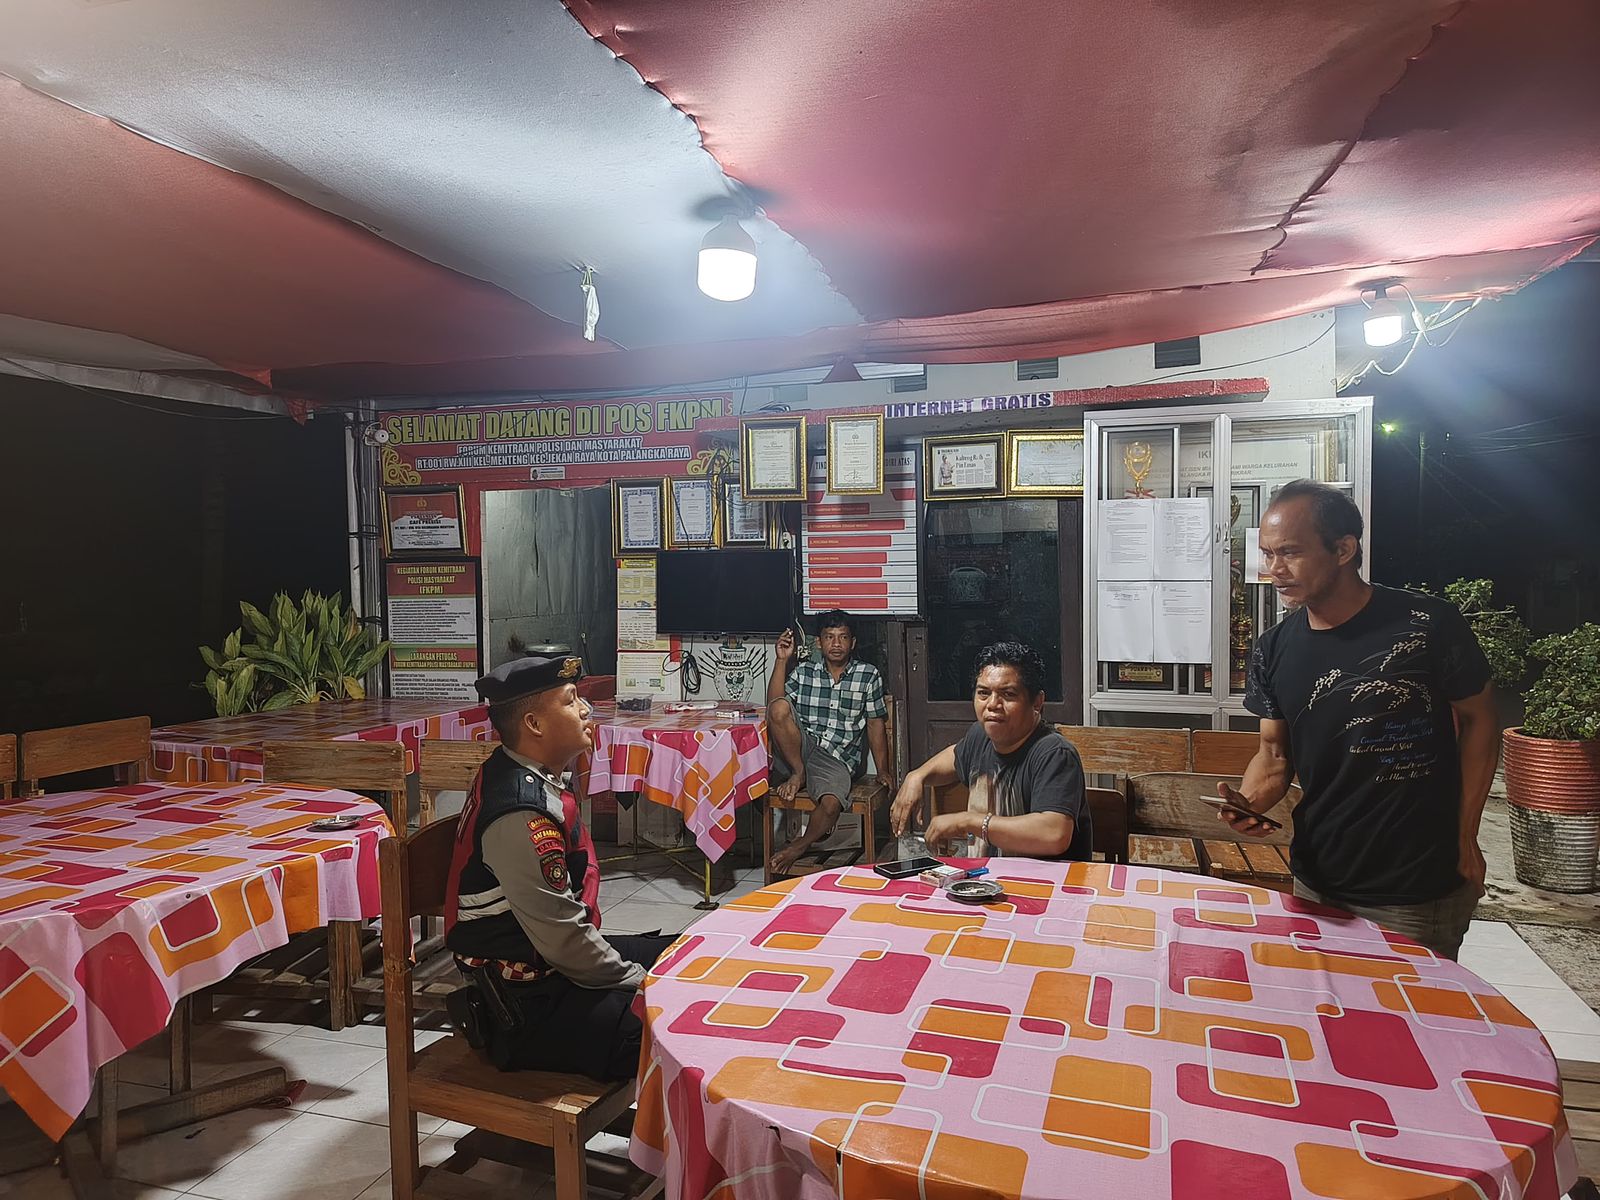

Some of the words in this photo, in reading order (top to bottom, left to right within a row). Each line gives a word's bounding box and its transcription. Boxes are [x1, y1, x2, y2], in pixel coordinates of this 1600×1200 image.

[887, 400, 974, 417] INTERNET
[981, 392, 1051, 411] GRATIS
[388, 412, 481, 444] SELAMAT
[485, 407, 571, 440] DATANG
[575, 405, 601, 436] DI
[604, 402, 652, 435] POS
[656, 399, 724, 432] FKPM
[458, 444, 486, 456] FORUM
[488, 442, 535, 455] KEMITRAAN
[537, 440, 563, 453] POLISI
[565, 439, 582, 452] DAN
[584, 437, 642, 451] MASYARAKAT
[417, 457, 443, 469] RT.001
[490, 453, 528, 466] MENTENG
[574, 451, 596, 462] RAYA
[597, 450, 618, 461] KOTA
[620, 448, 666, 460] PALANGKA
[667, 447, 691, 458] RAYA
[397, 566, 419, 575] KEGIATAN
[420, 566, 437, 574] FORUM
[438, 565, 465, 574] KEMITRAAN
[407, 576, 423, 584] POLISI
[424, 575, 455, 584] MASYARAKAT
[419, 586, 443, 594] (FKPM)
[411, 652, 436, 661] LARANGAN
[436, 652, 457, 661] PETUGAS
